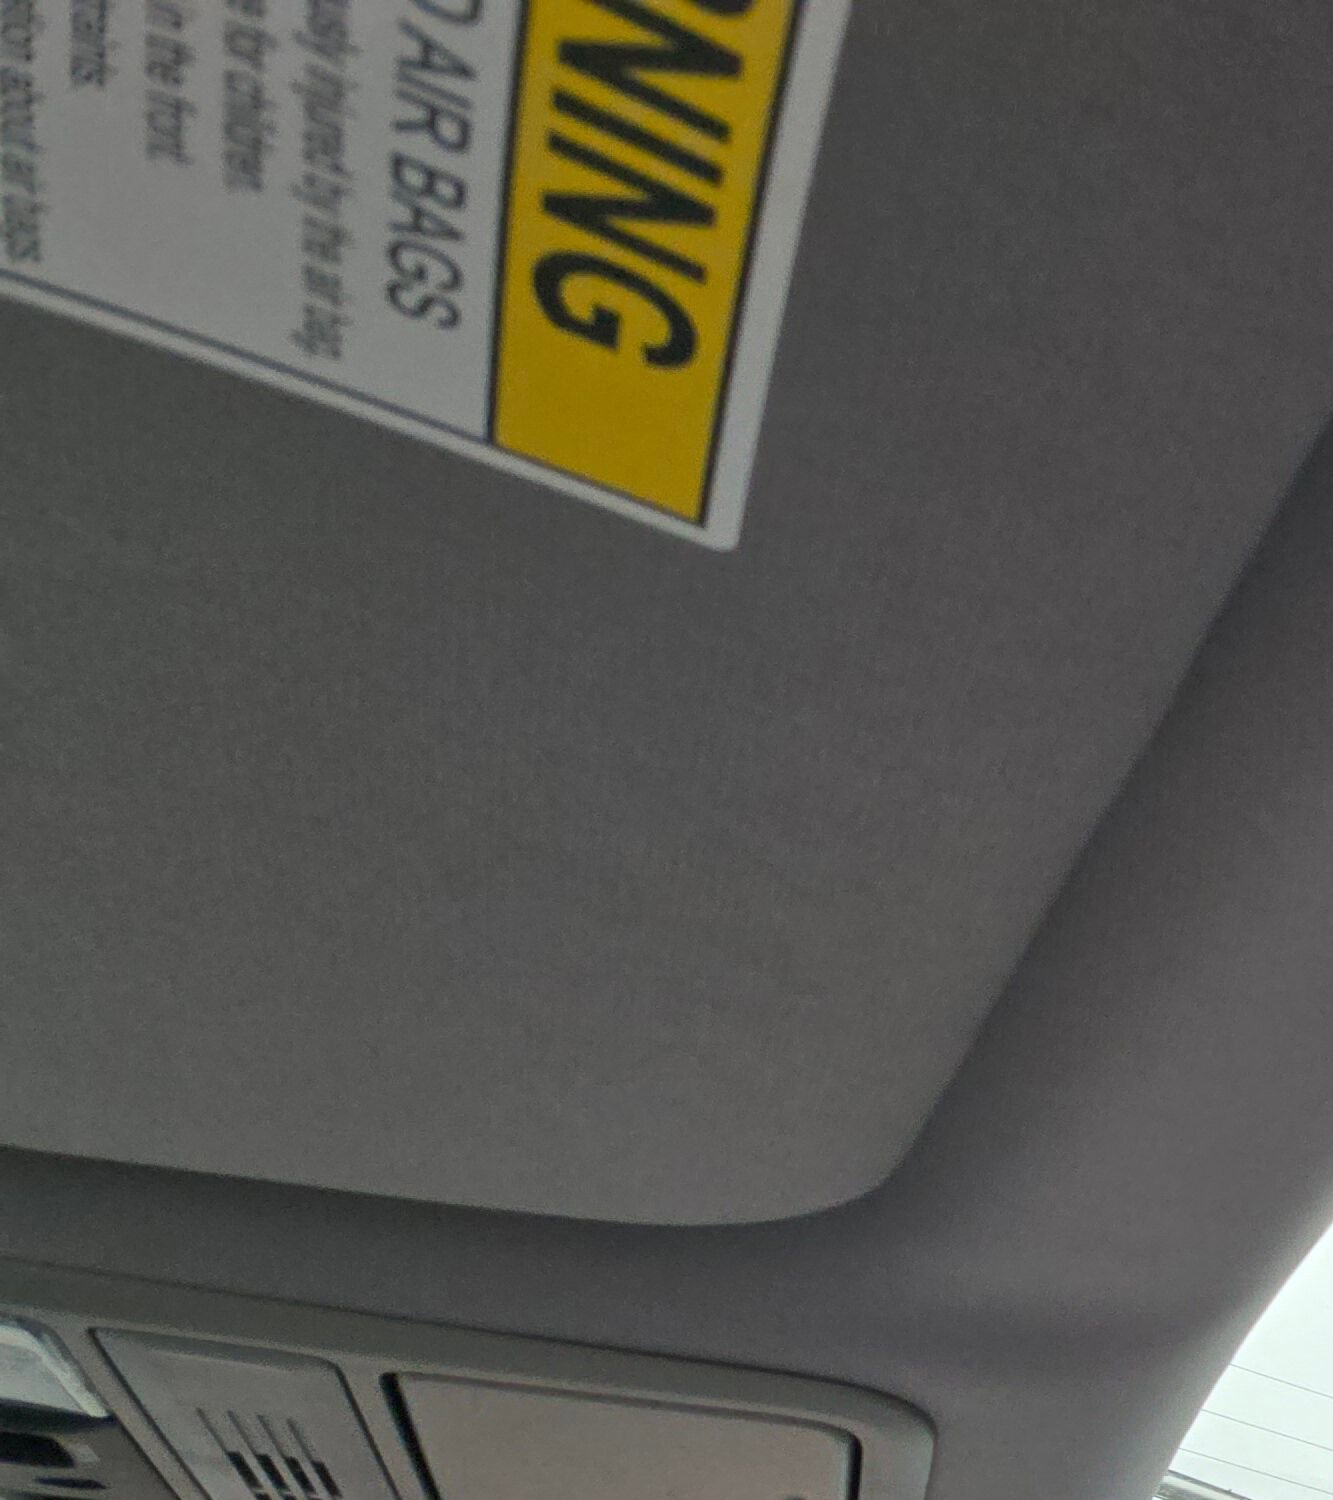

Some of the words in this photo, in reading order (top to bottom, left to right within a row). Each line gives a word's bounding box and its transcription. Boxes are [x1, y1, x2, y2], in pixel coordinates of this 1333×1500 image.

[221, 20, 280, 71] for
[391, 19, 478, 155] AIR
[293, 64, 358, 176] injured
[301, 215, 355, 264] the
[385, 153, 470, 331] BAGS
